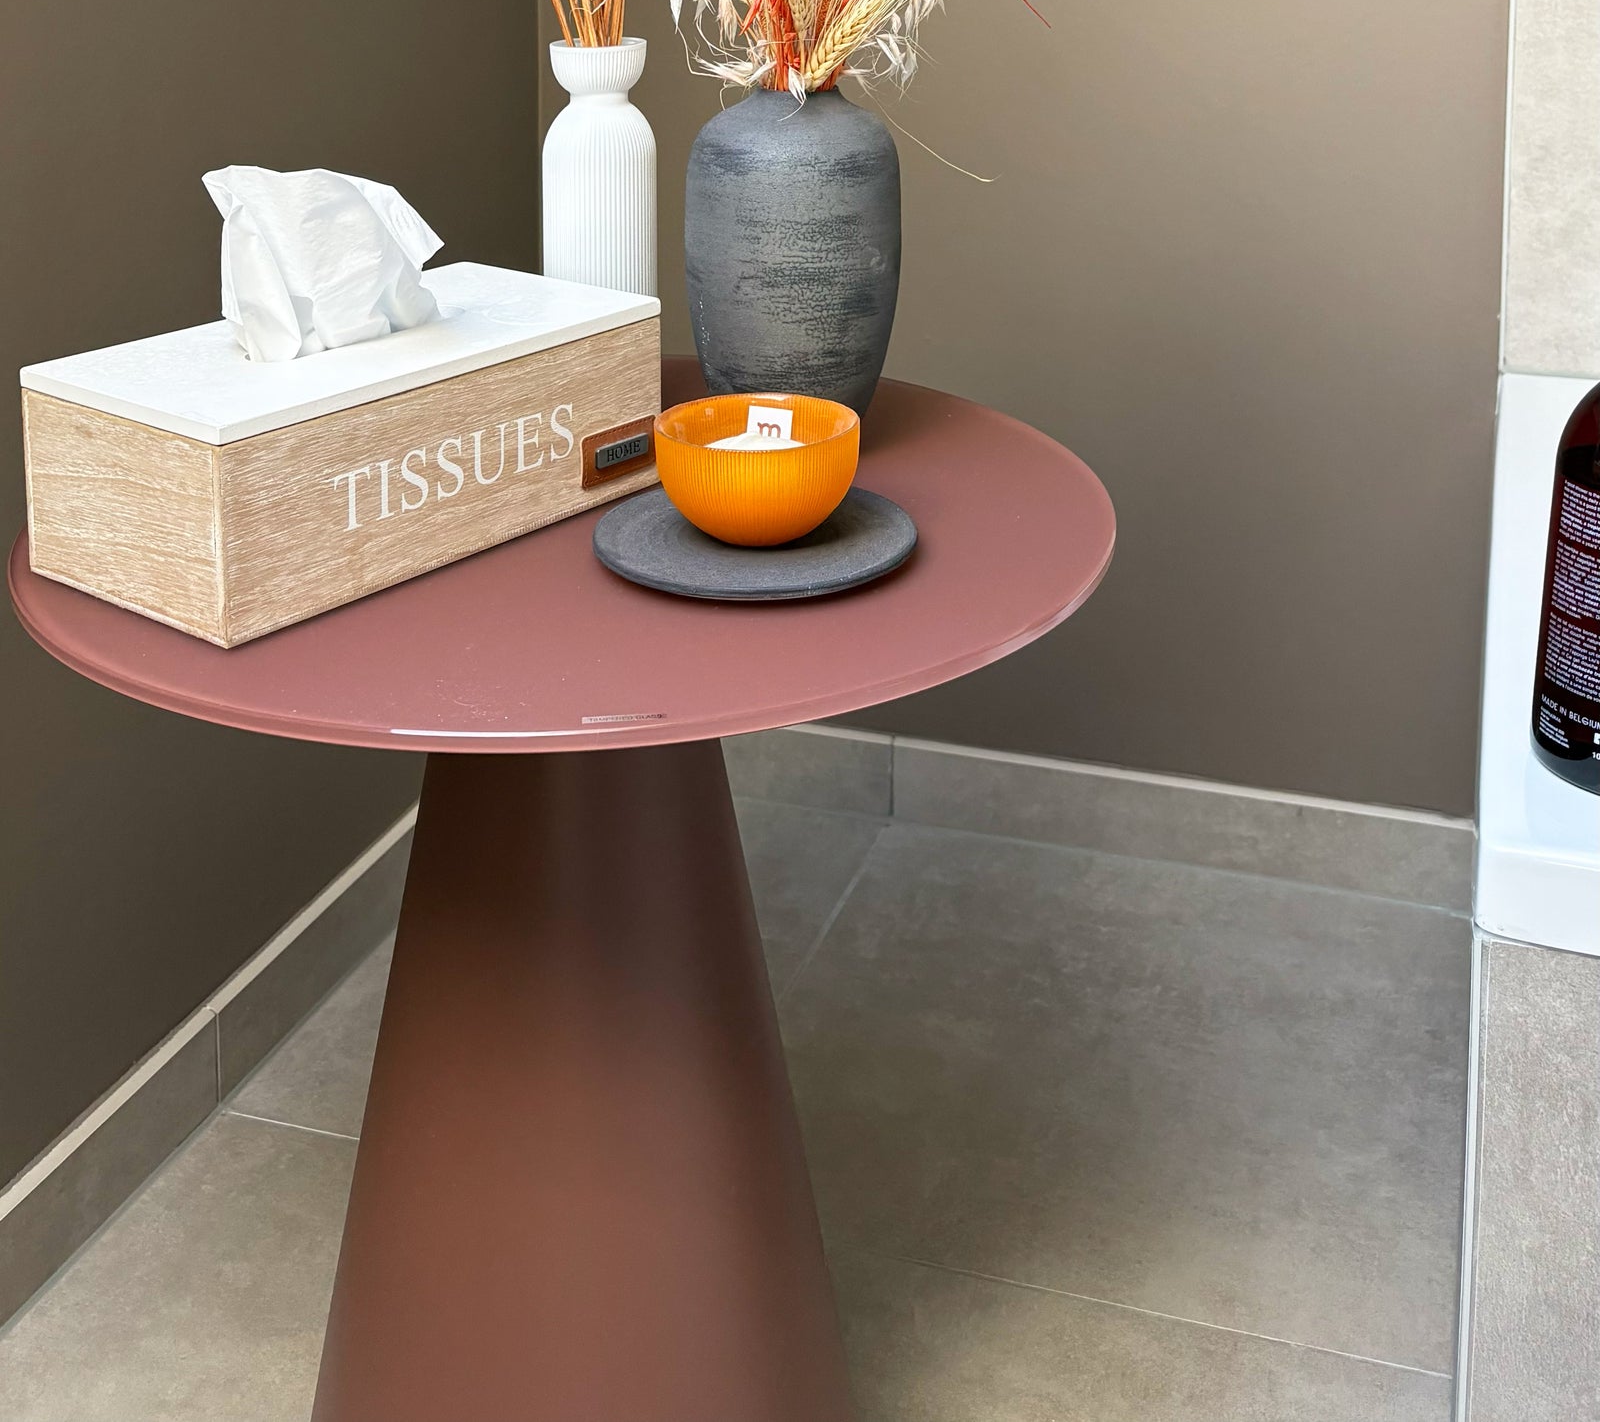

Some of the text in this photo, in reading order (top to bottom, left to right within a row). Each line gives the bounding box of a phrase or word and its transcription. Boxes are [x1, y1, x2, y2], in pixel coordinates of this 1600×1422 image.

[606, 439, 641, 463] HOME
[332, 403, 574, 532] TISSUES
[1541, 693, 1559, 712] MADE
[1559, 705, 1568, 716] IN
